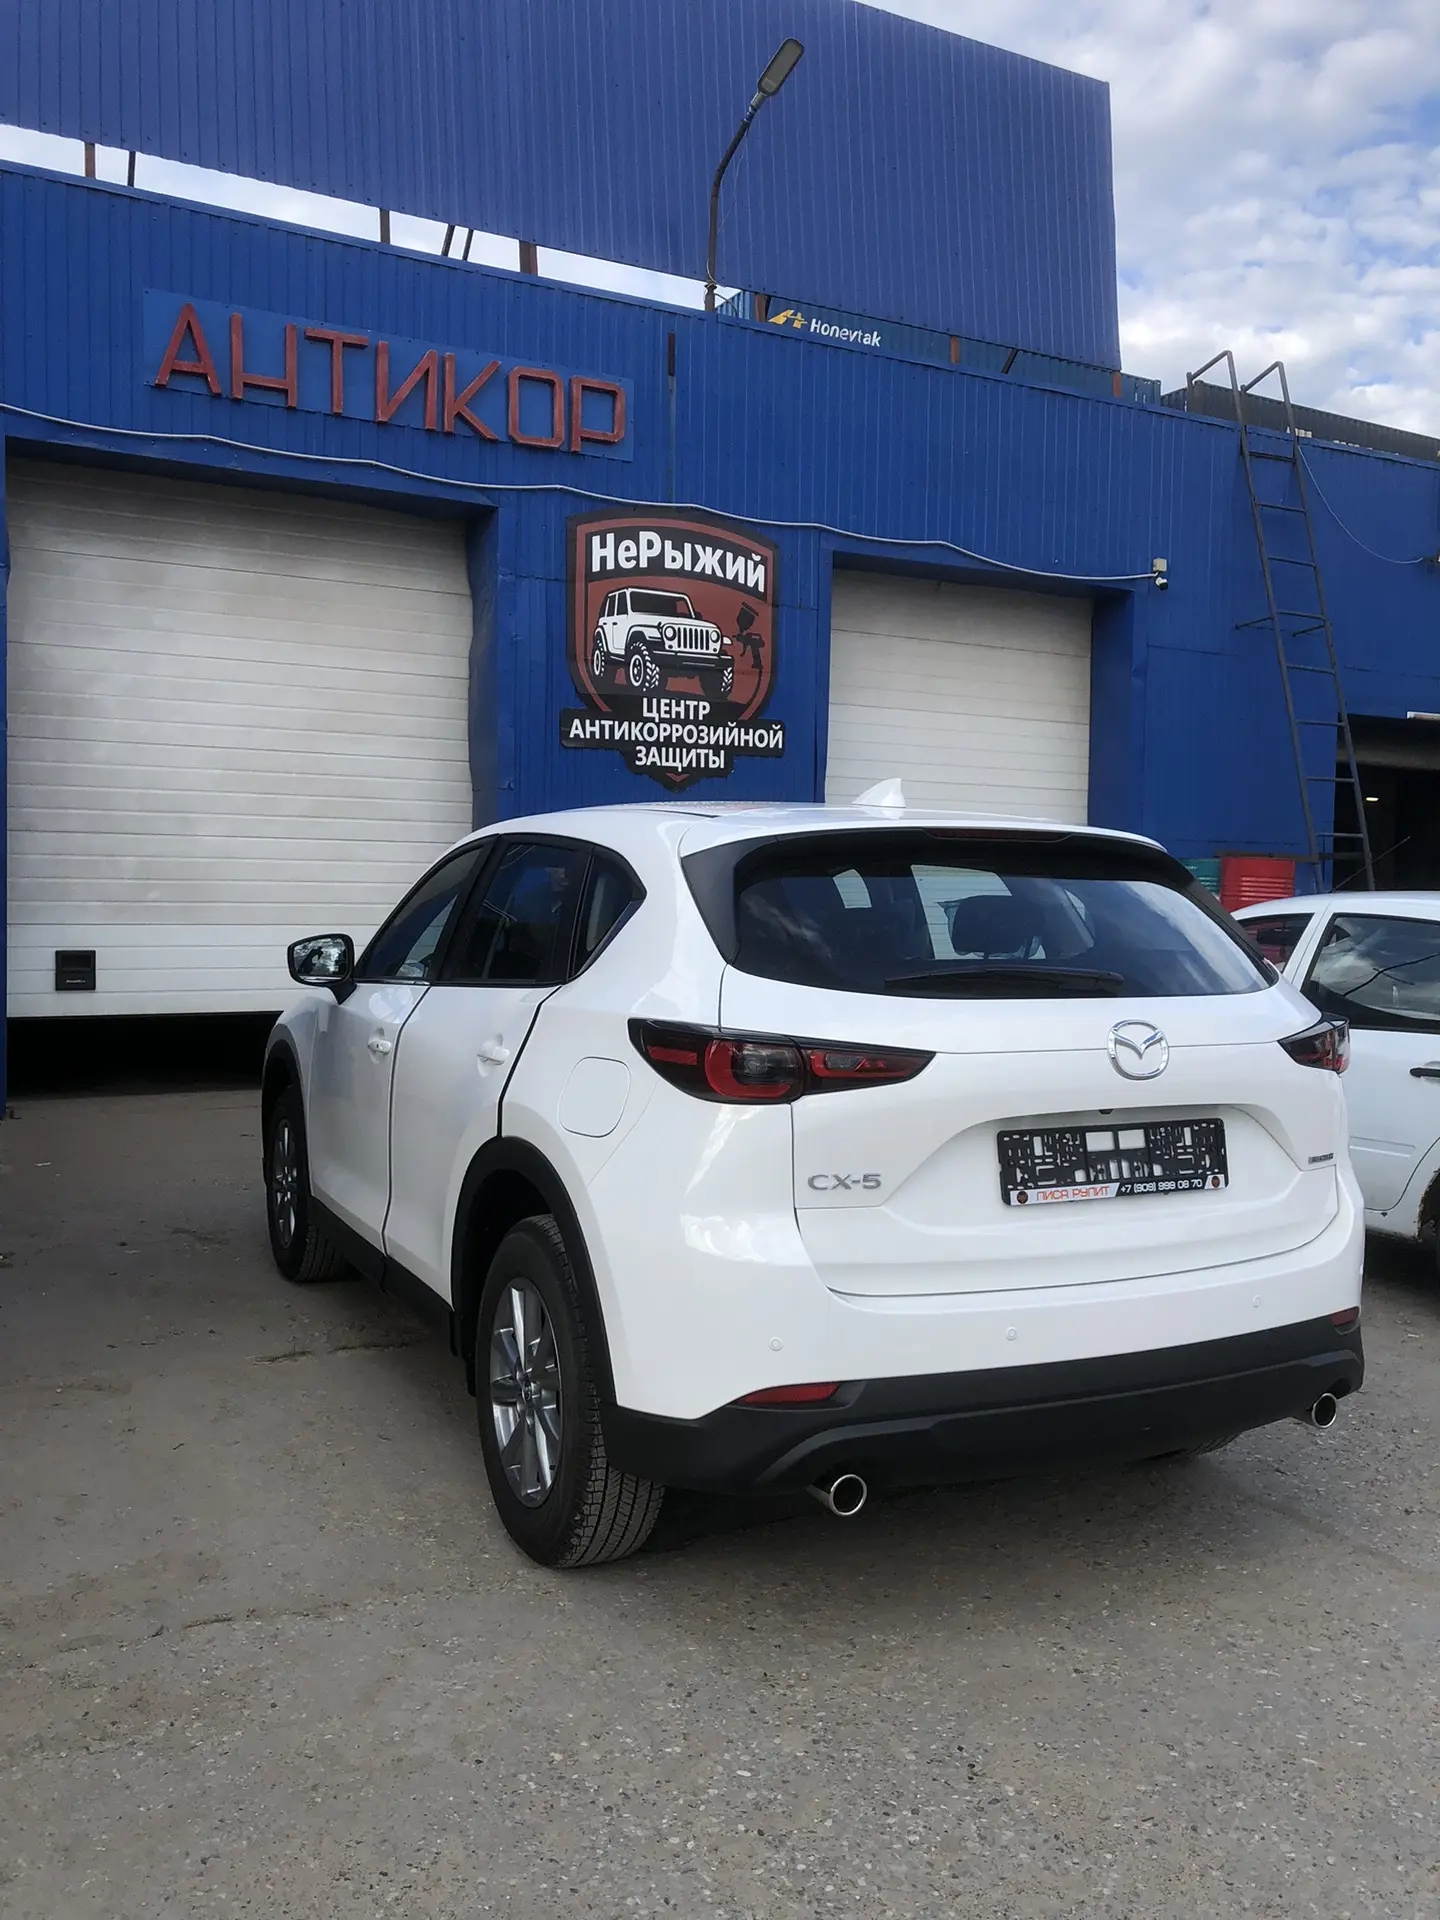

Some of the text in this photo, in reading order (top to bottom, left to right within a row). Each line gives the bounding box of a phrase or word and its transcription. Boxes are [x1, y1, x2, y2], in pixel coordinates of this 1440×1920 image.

[155, 303, 626, 453] АНТИКОР
[591, 530, 766, 593] НеРыжий
[642, 697, 711, 722] ЦЕНТР
[569, 718, 784, 749] АНТИКОРРОЗИЙНОЙ
[635, 746, 725, 772] ЗАЩИТЫ
[807, 1173, 882, 1190] CX-5
[1120, 1184, 1132, 1194] +7
[1133, 1181, 1157, 1194] (909)
[1177, 1179, 1190, 1190] 08
[1191, 1178, 1203, 1188] 70
